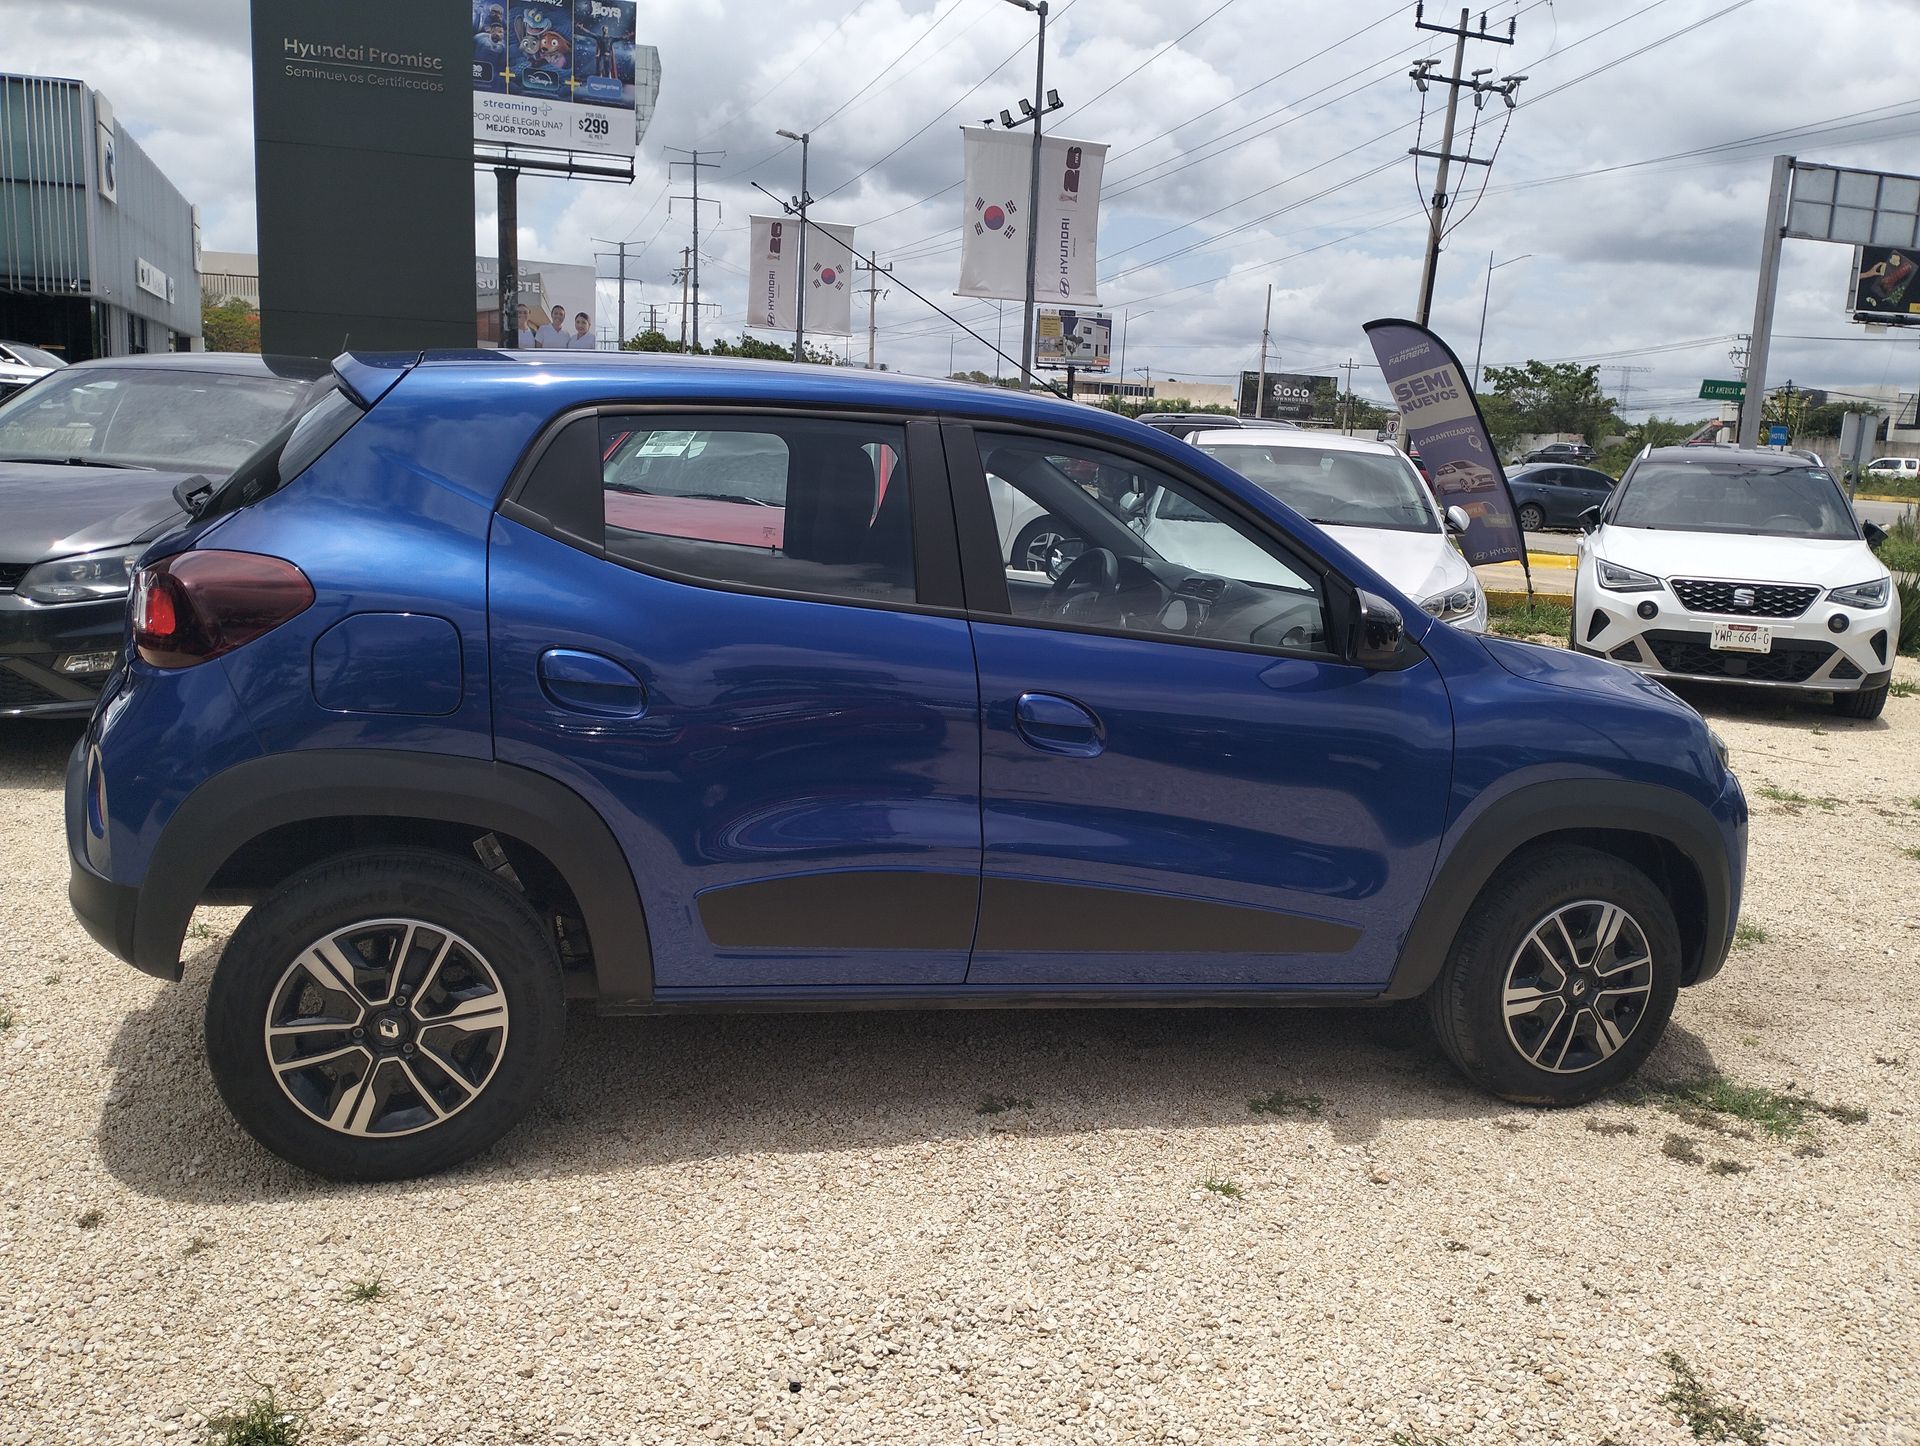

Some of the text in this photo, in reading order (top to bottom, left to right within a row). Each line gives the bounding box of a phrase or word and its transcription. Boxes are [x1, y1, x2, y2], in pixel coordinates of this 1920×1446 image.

[284, 38, 364, 62] Hyundai
[285, 65, 444, 92] Seminuevos Certificados
[483, 99, 538, 115] streaming
[486, 124, 546, 137] MEJOR TODAS
[492, 113, 510, 124] QUÉ
[512, 117, 540, 128] ELEGIR
[542, 120, 563, 130] UNA?
[578, 118, 609, 135] $299
[1060, 218, 1071, 274] HYUNDAI
[1388, 346, 1431, 366] FARRERA
[1273, 384, 1310, 398] Soco
[1394, 370, 1454, 402] SEMI
[1704, 385, 1714, 393] LAS
[1400, 389, 1459, 414] NUEVOS
[1419, 426, 1475, 446] GARANTIZADOS
[1714, 629, 1769, 645] YWR-664-G
